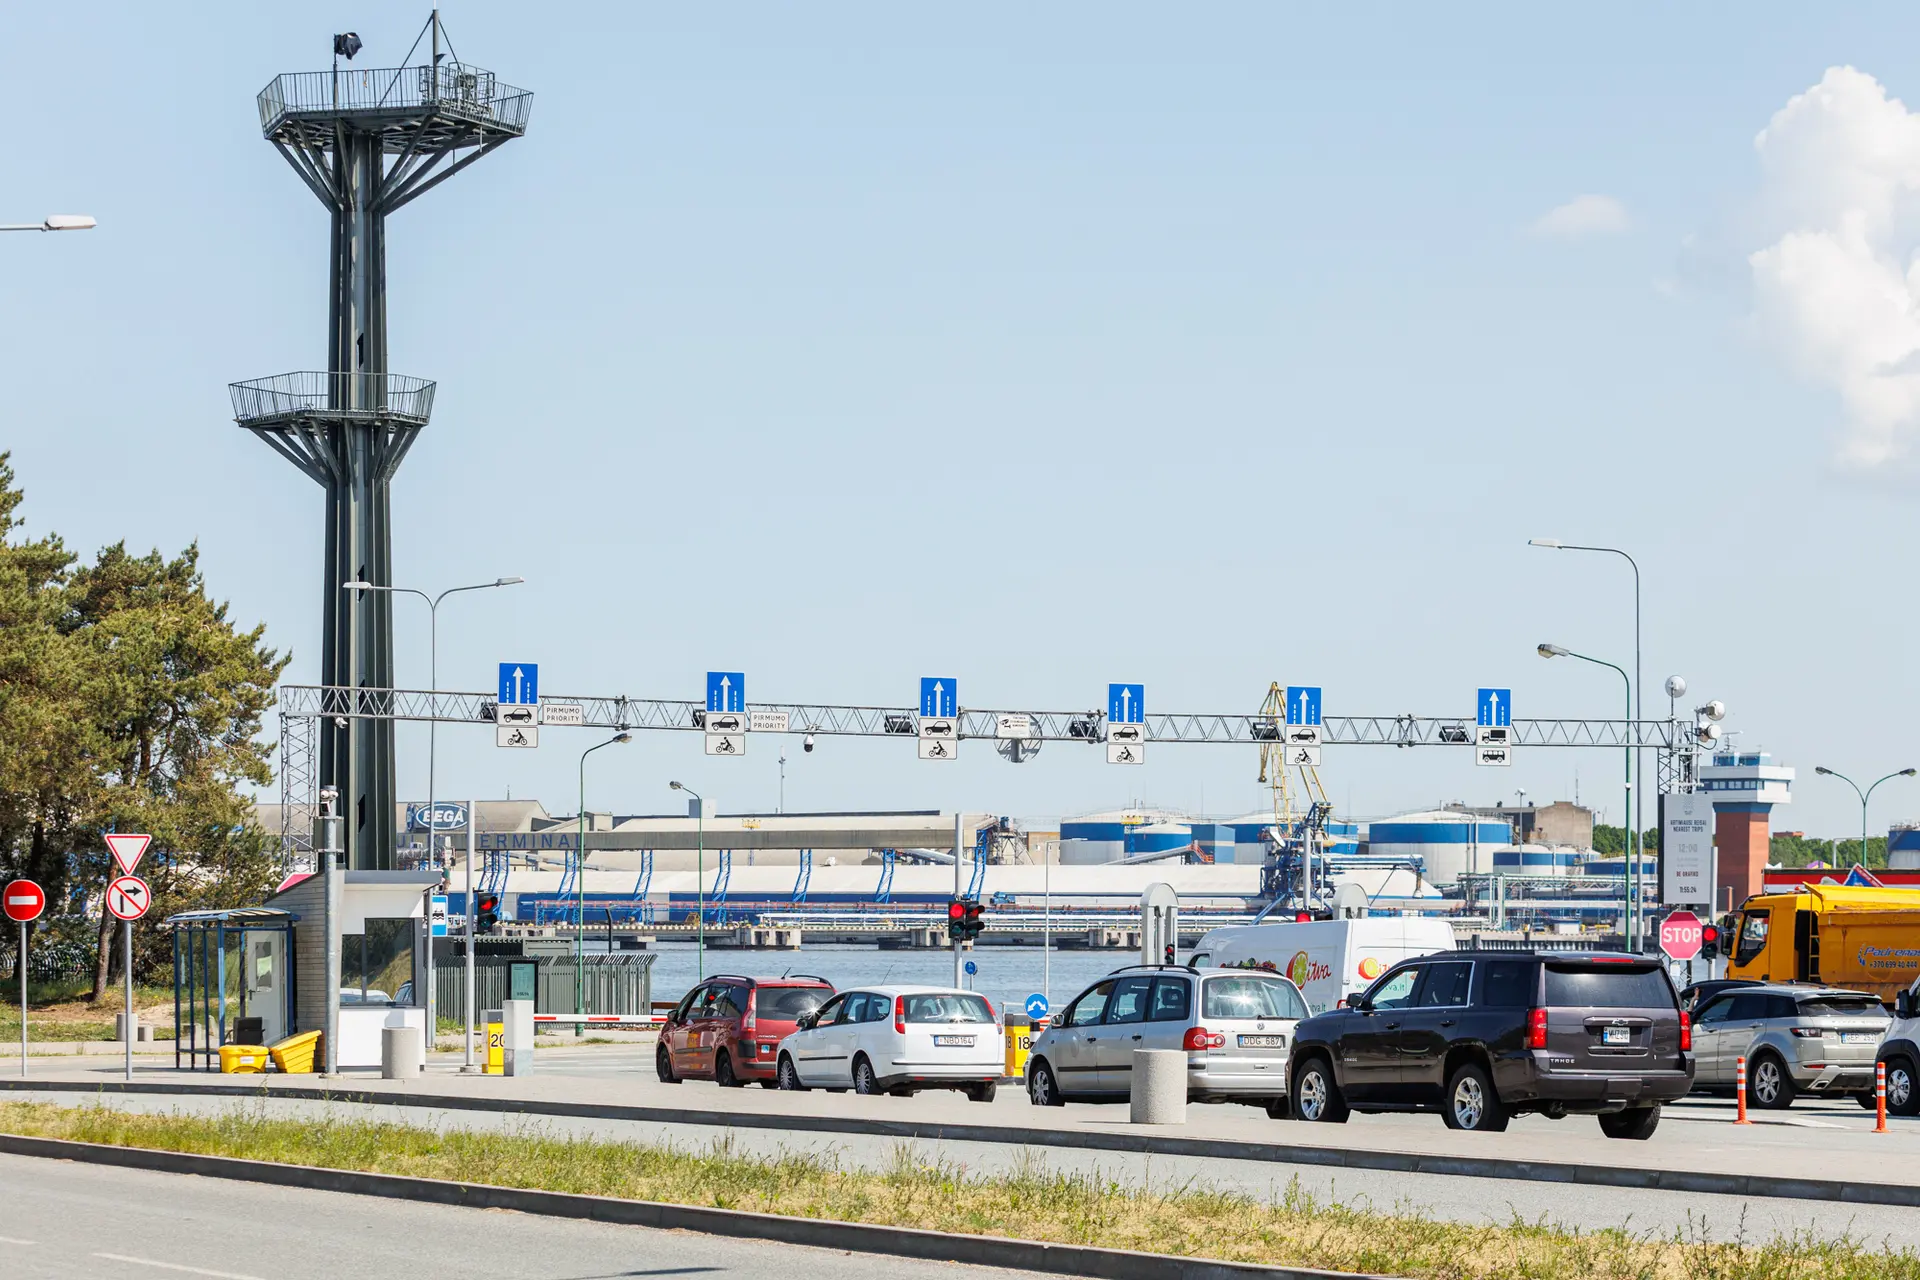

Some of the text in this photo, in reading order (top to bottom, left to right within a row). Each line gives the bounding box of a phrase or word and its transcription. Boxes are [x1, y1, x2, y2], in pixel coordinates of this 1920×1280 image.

[1663, 927, 1701, 943] STOP
[1018, 1036, 1030, 1050] 18
[1244, 1036, 1280, 1045] DDG 687
